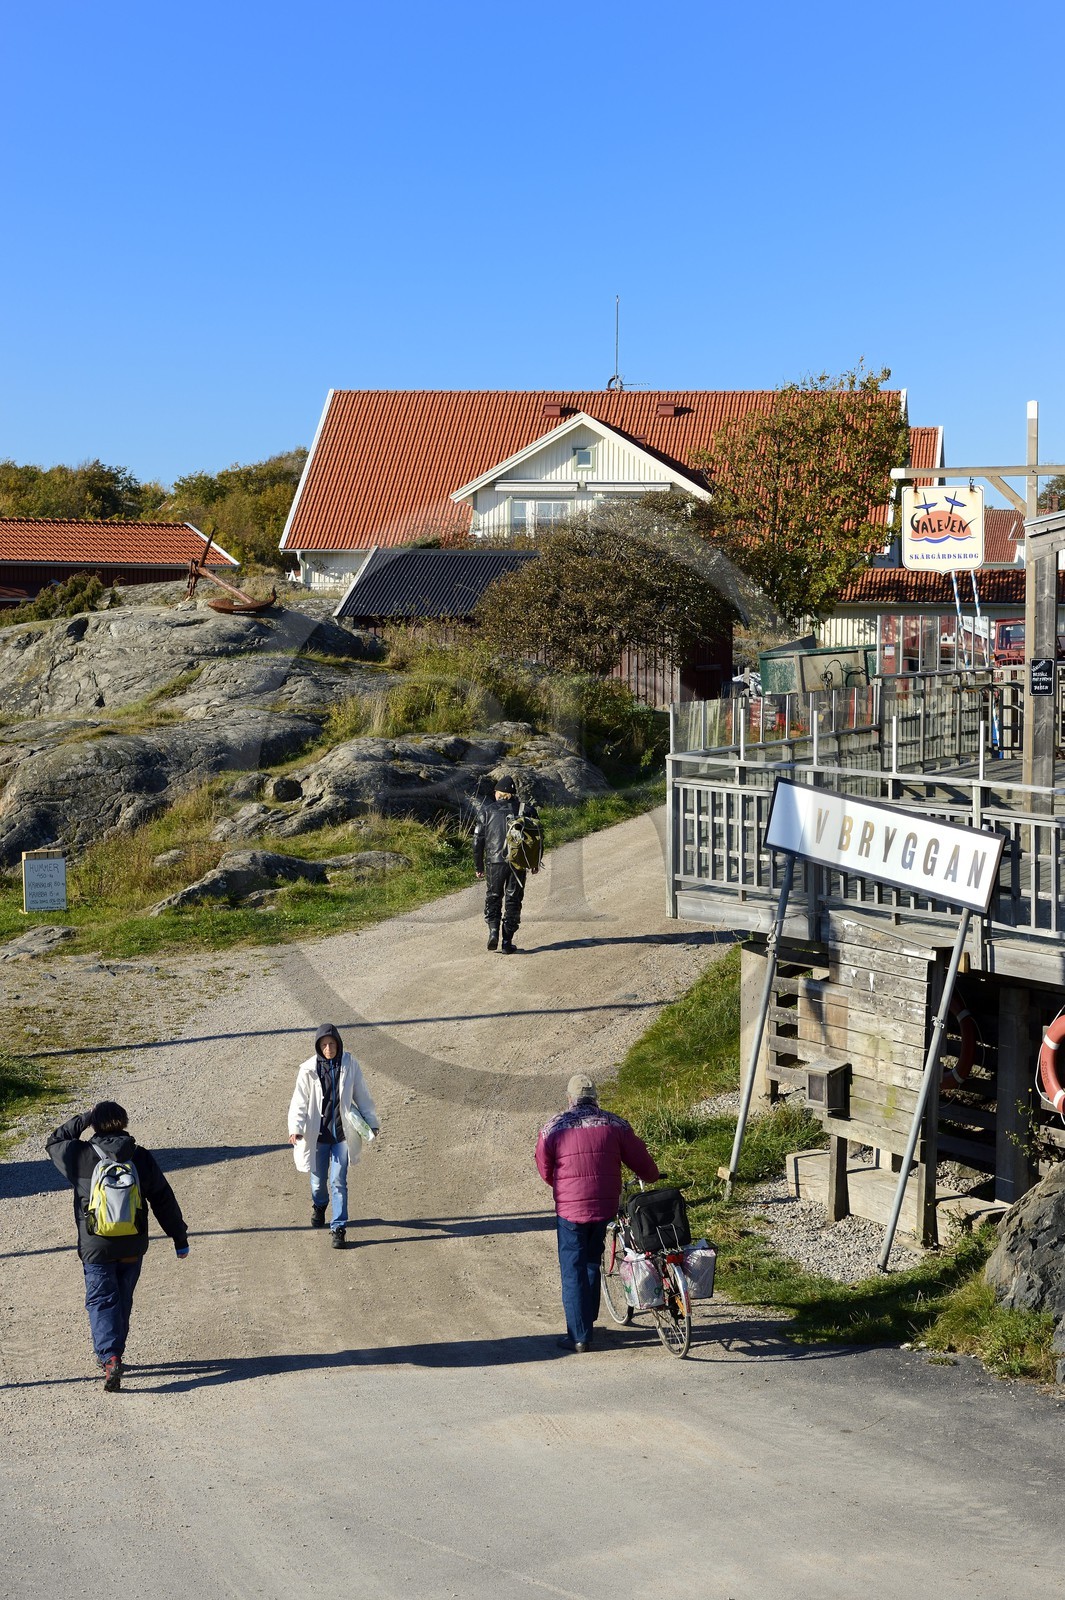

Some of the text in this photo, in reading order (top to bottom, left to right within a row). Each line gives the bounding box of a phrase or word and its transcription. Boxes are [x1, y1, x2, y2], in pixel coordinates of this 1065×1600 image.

[910, 513, 977, 534] GALEJEN
[909, 552, 979, 560] SKÄRGÅRDSKROG
[838, 815, 987, 890] BRYGGAN
[30, 863, 59, 873] HUMMER
